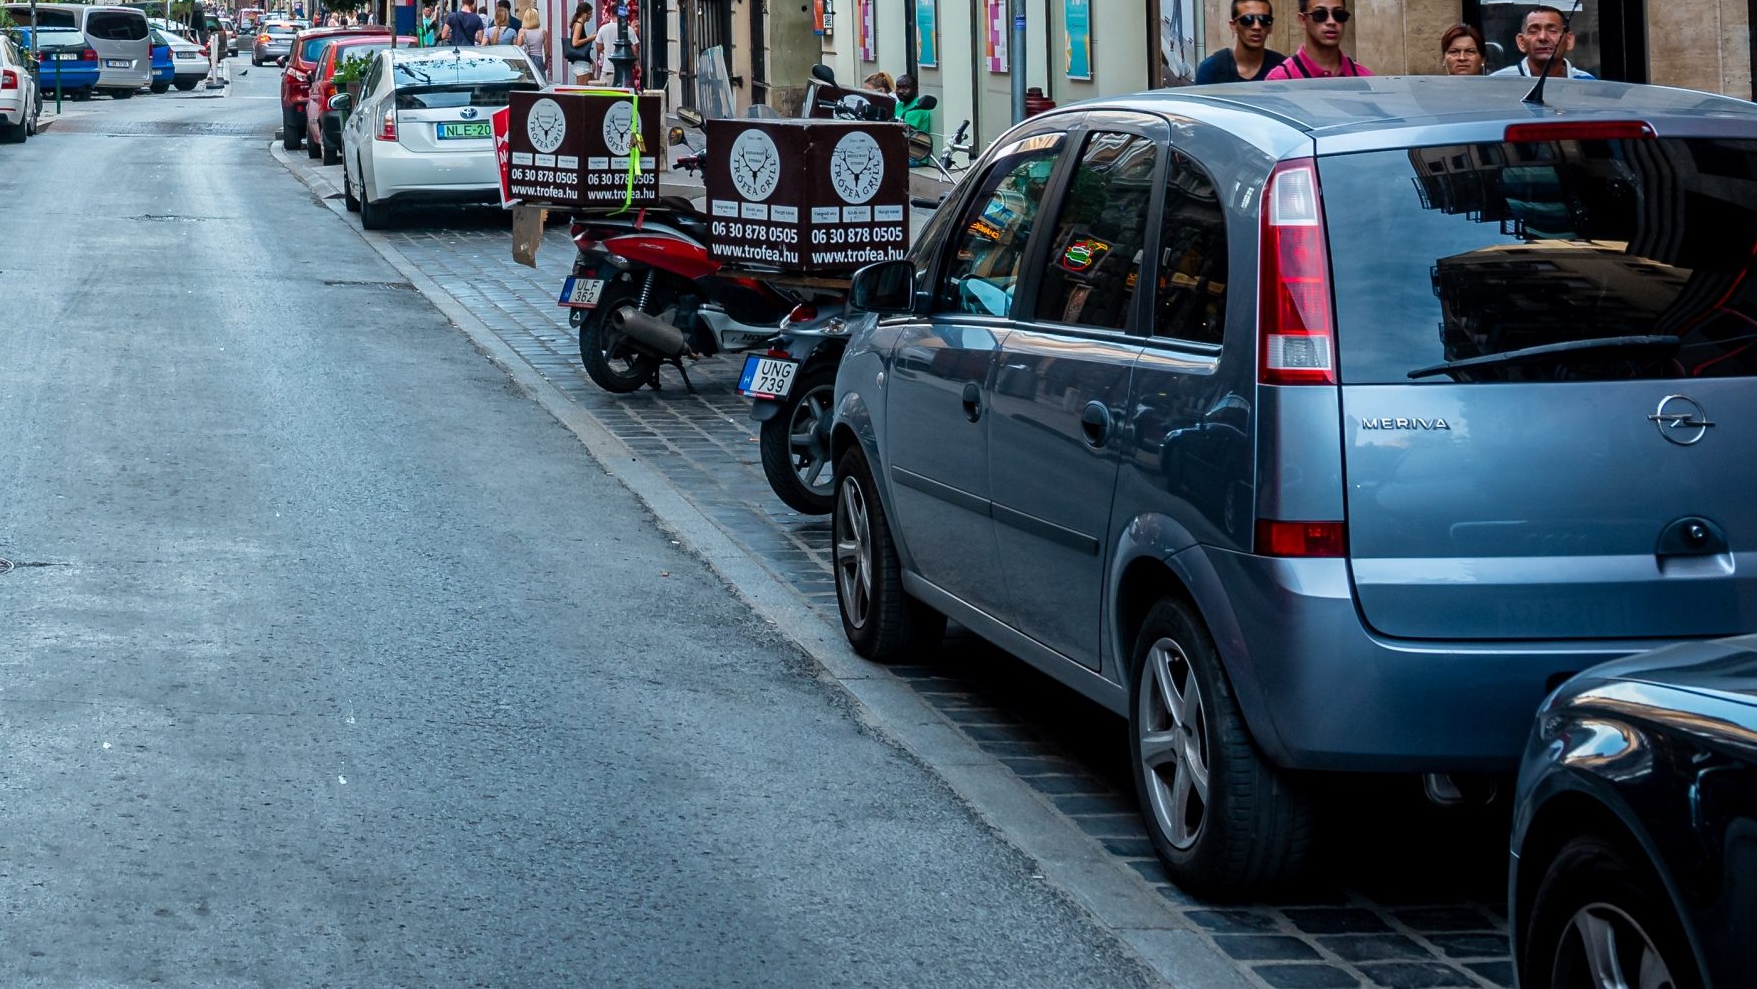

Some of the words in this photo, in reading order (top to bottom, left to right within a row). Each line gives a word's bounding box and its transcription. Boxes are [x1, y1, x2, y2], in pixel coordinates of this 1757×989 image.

[446, 124, 491, 136] NLE-20
[511, 168, 523, 180] 06
[525, 169, 536, 181] 30
[537, 170, 554, 182] 878
[555, 171, 578, 185] 0505
[588, 174, 599, 185] 06
[601, 173, 612, 185] 30
[760, 159, 777, 194] GRILL
[511, 184, 578, 200] www.trofea.hu
[588, 187, 655, 200] www.troea.hu
[712, 221, 726, 236] 06
[729, 222, 743, 238] 30
[745, 224, 767, 241] 878
[769, 227, 798, 244] 0505
[812, 229, 827, 244] 06
[829, 228, 844, 243] 30
[847, 228, 870, 243] 878
[873, 227, 903, 242] 0505
[712, 243, 798, 264] www.trofea.hu
[812, 246, 903, 264] www.trofea.hu
[577, 280, 599, 291] ULF
[574, 291, 594, 302] 362
[762, 360, 792, 378] UNG
[758, 376, 785, 393] 739
[1362, 418, 1451, 430] MERIVA
